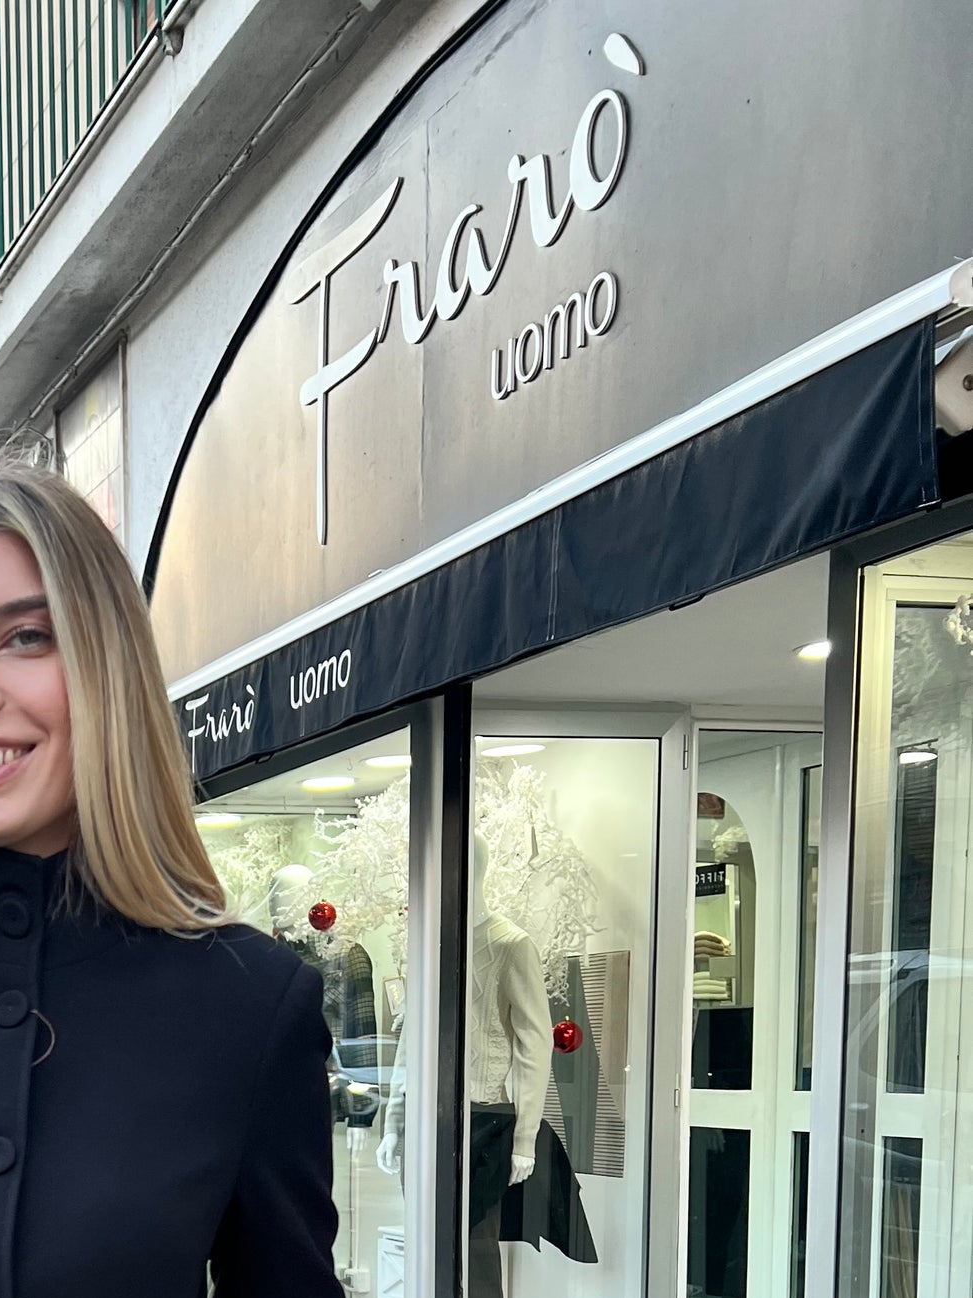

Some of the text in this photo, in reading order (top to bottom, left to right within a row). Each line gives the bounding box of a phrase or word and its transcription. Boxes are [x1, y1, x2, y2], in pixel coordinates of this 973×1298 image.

[286, 32, 646, 546] Frarò
[490, 270, 619, 401] uomo
[184, 648, 352, 774] Frarò uomo
